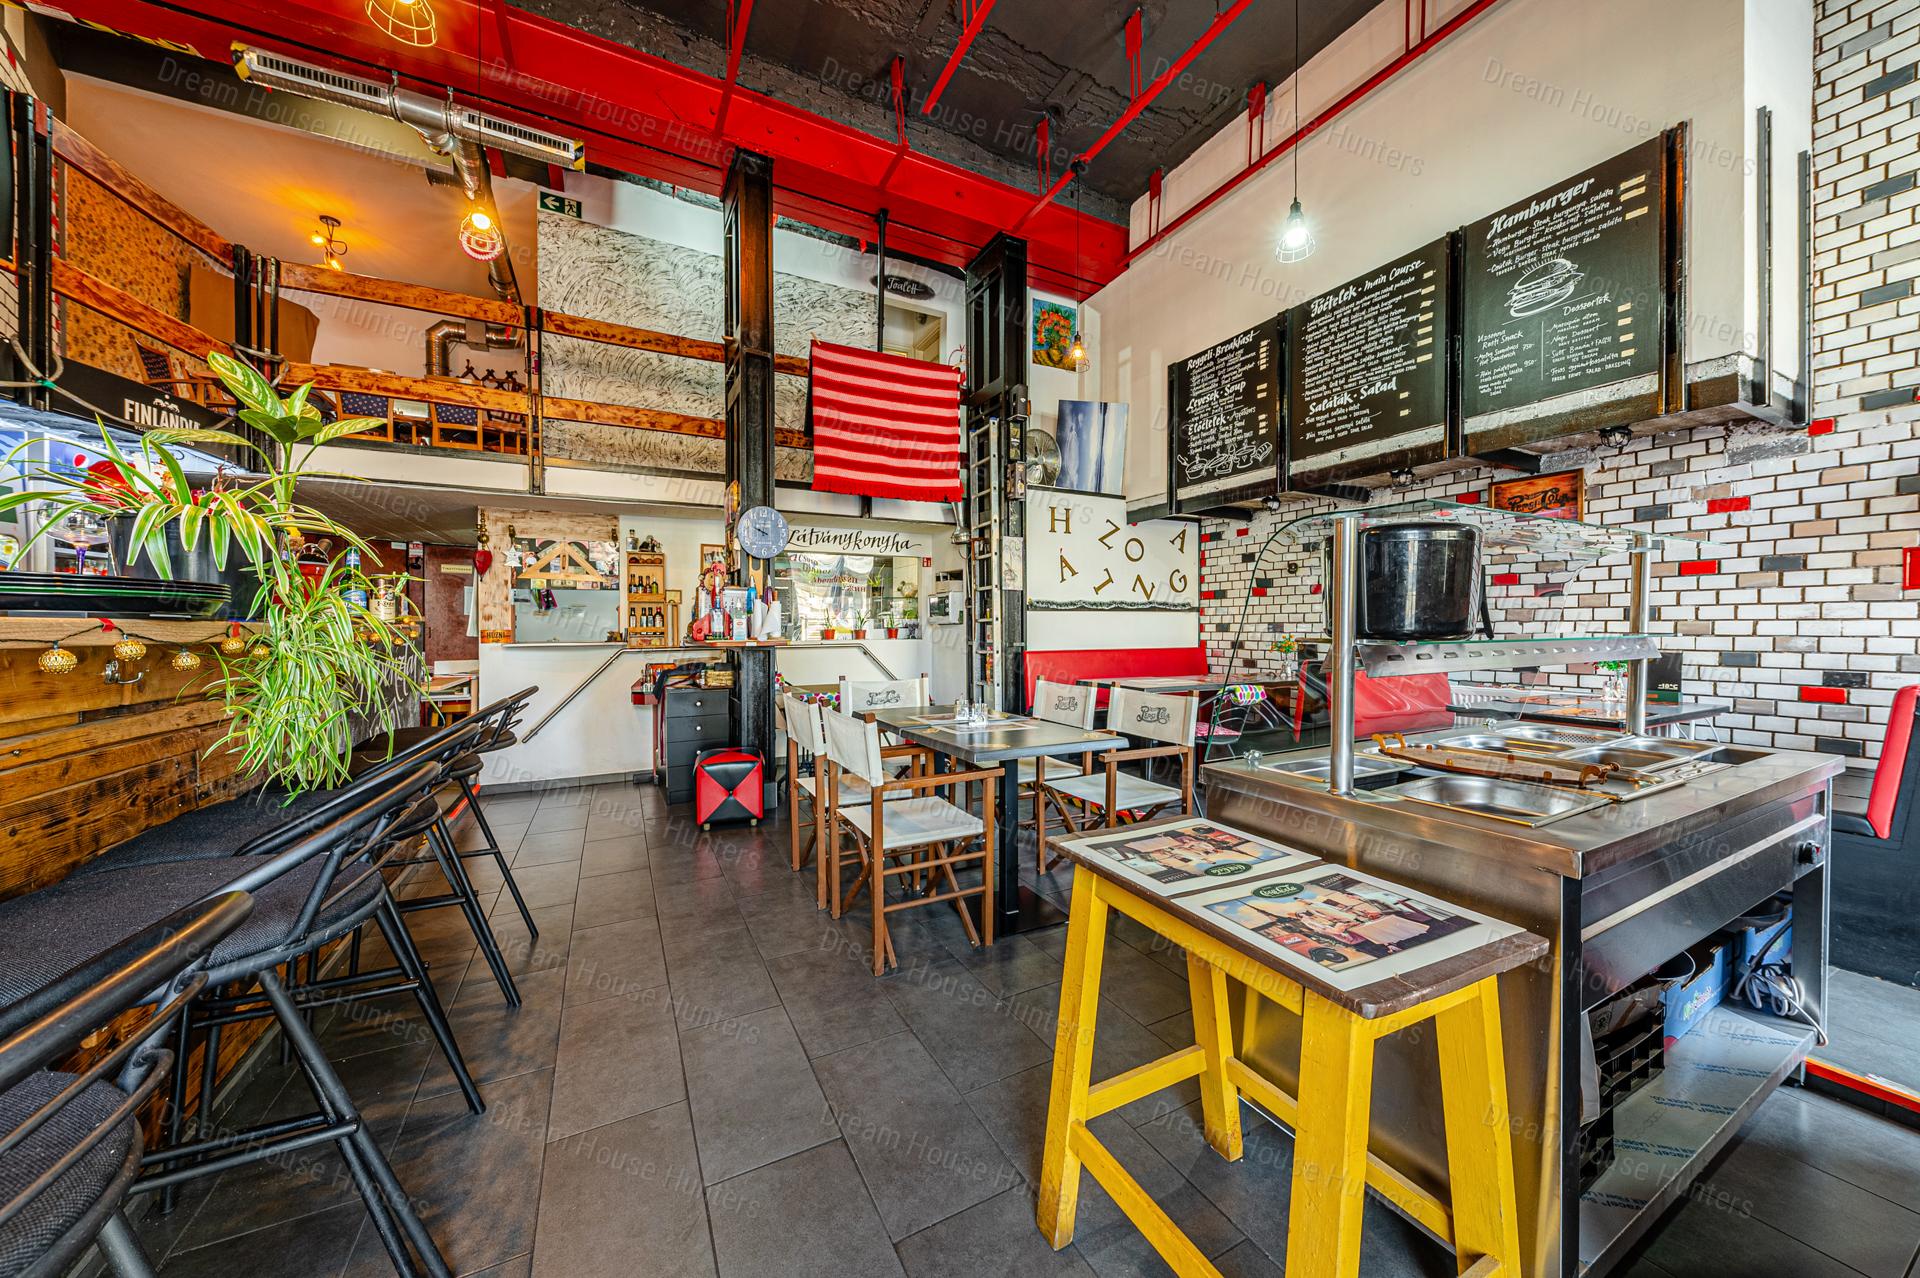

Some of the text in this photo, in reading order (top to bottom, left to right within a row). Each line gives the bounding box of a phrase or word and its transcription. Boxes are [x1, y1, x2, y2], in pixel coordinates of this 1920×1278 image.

[1486, 178, 1594, 239] Hamburger
[887, 277, 925, 294] Toalett
[1388, 259, 1425, 281] Course
[1186, 330, 1254, 371] Reggeli Breakfast
[1185, 390, 1219, 411] Levesek
[1223, 380, 1246, 396] Soup
[1308, 392, 1353, 415] Saláták
[1359, 376, 1397, 399] Salad
[124, 398, 201, 430] FINLANDIA
[787, 528, 922, 553] Látványkonyha
[1049, 506, 1072, 534] H
[1124, 537, 1144, 562] O
[1169, 568, 1188, 593] G
